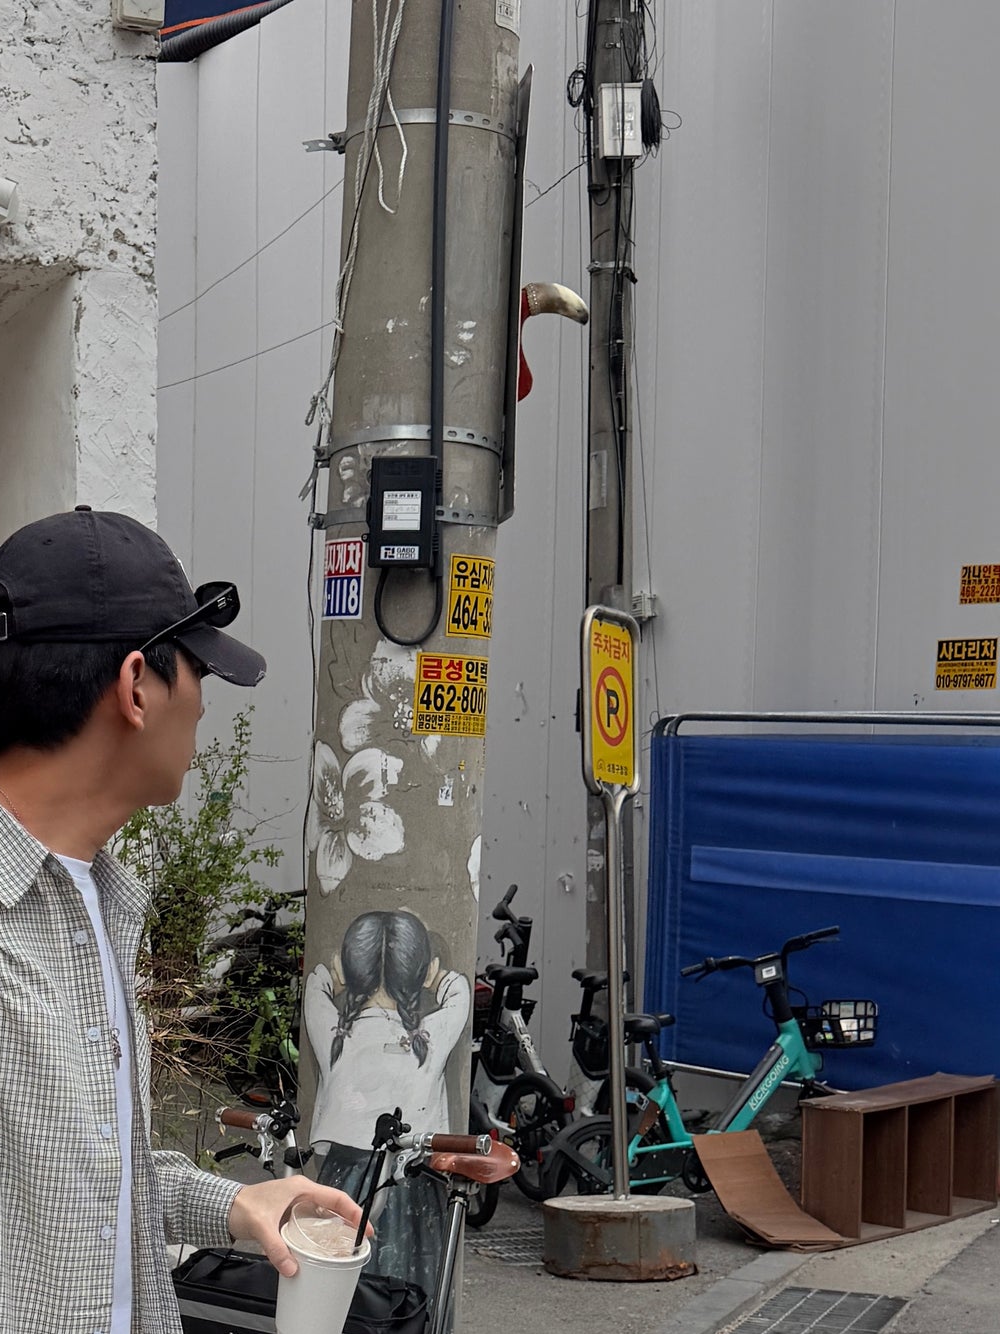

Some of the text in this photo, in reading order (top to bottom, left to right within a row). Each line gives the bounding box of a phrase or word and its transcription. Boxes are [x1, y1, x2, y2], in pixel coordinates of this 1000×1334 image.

[593, 631, 630, 664] 주차금지
[939, 639, 996, 661] 사다리차
[748, 1055, 790, 1111] KICKGOING
